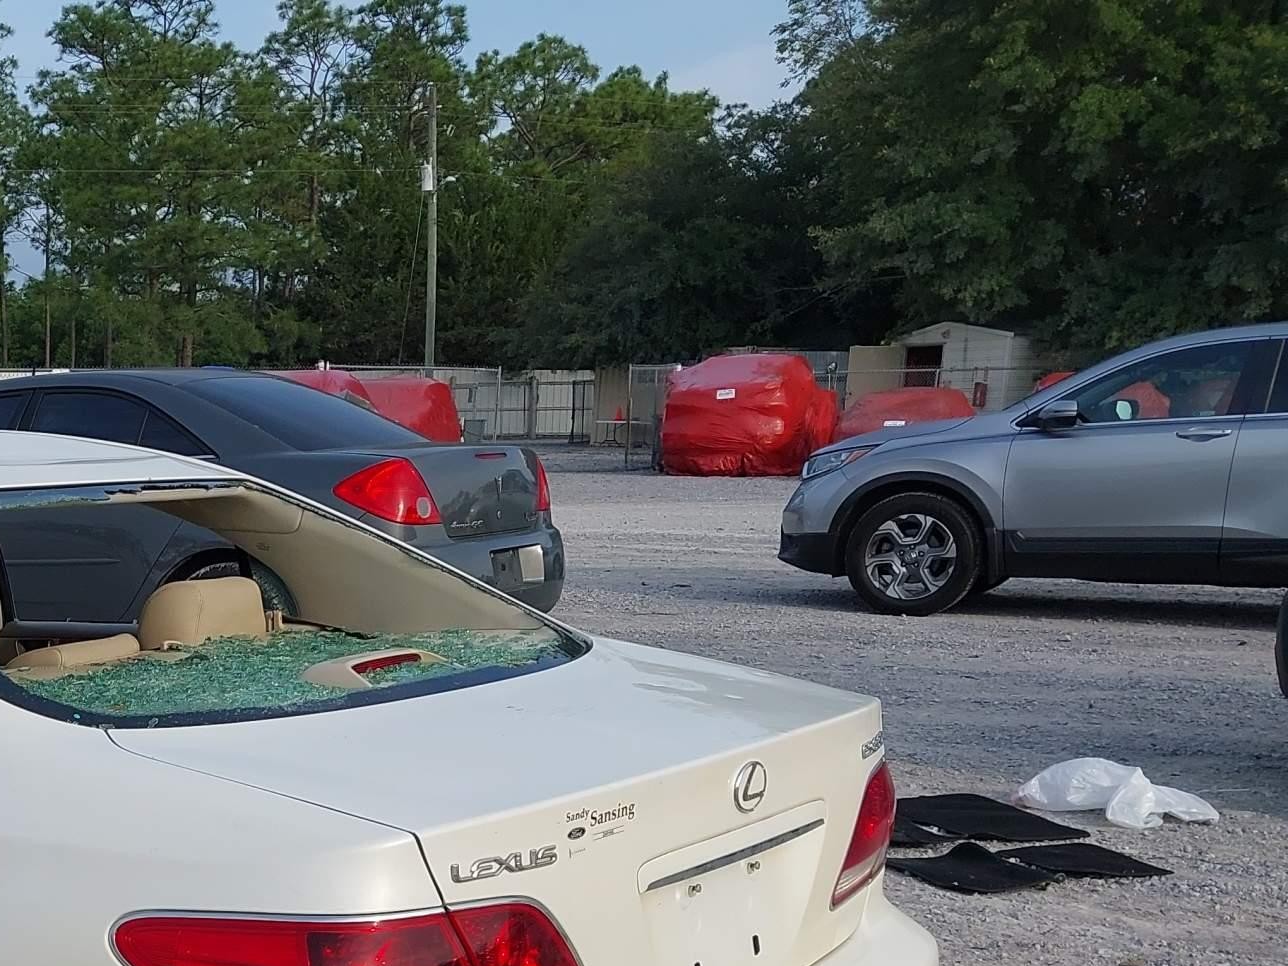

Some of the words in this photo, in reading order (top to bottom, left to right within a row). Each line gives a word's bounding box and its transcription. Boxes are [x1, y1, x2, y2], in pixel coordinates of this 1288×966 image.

[566, 808, 590, 823] Sandy
[590, 803, 635, 827] Sansing
[450, 844, 558, 884] LEXUS
